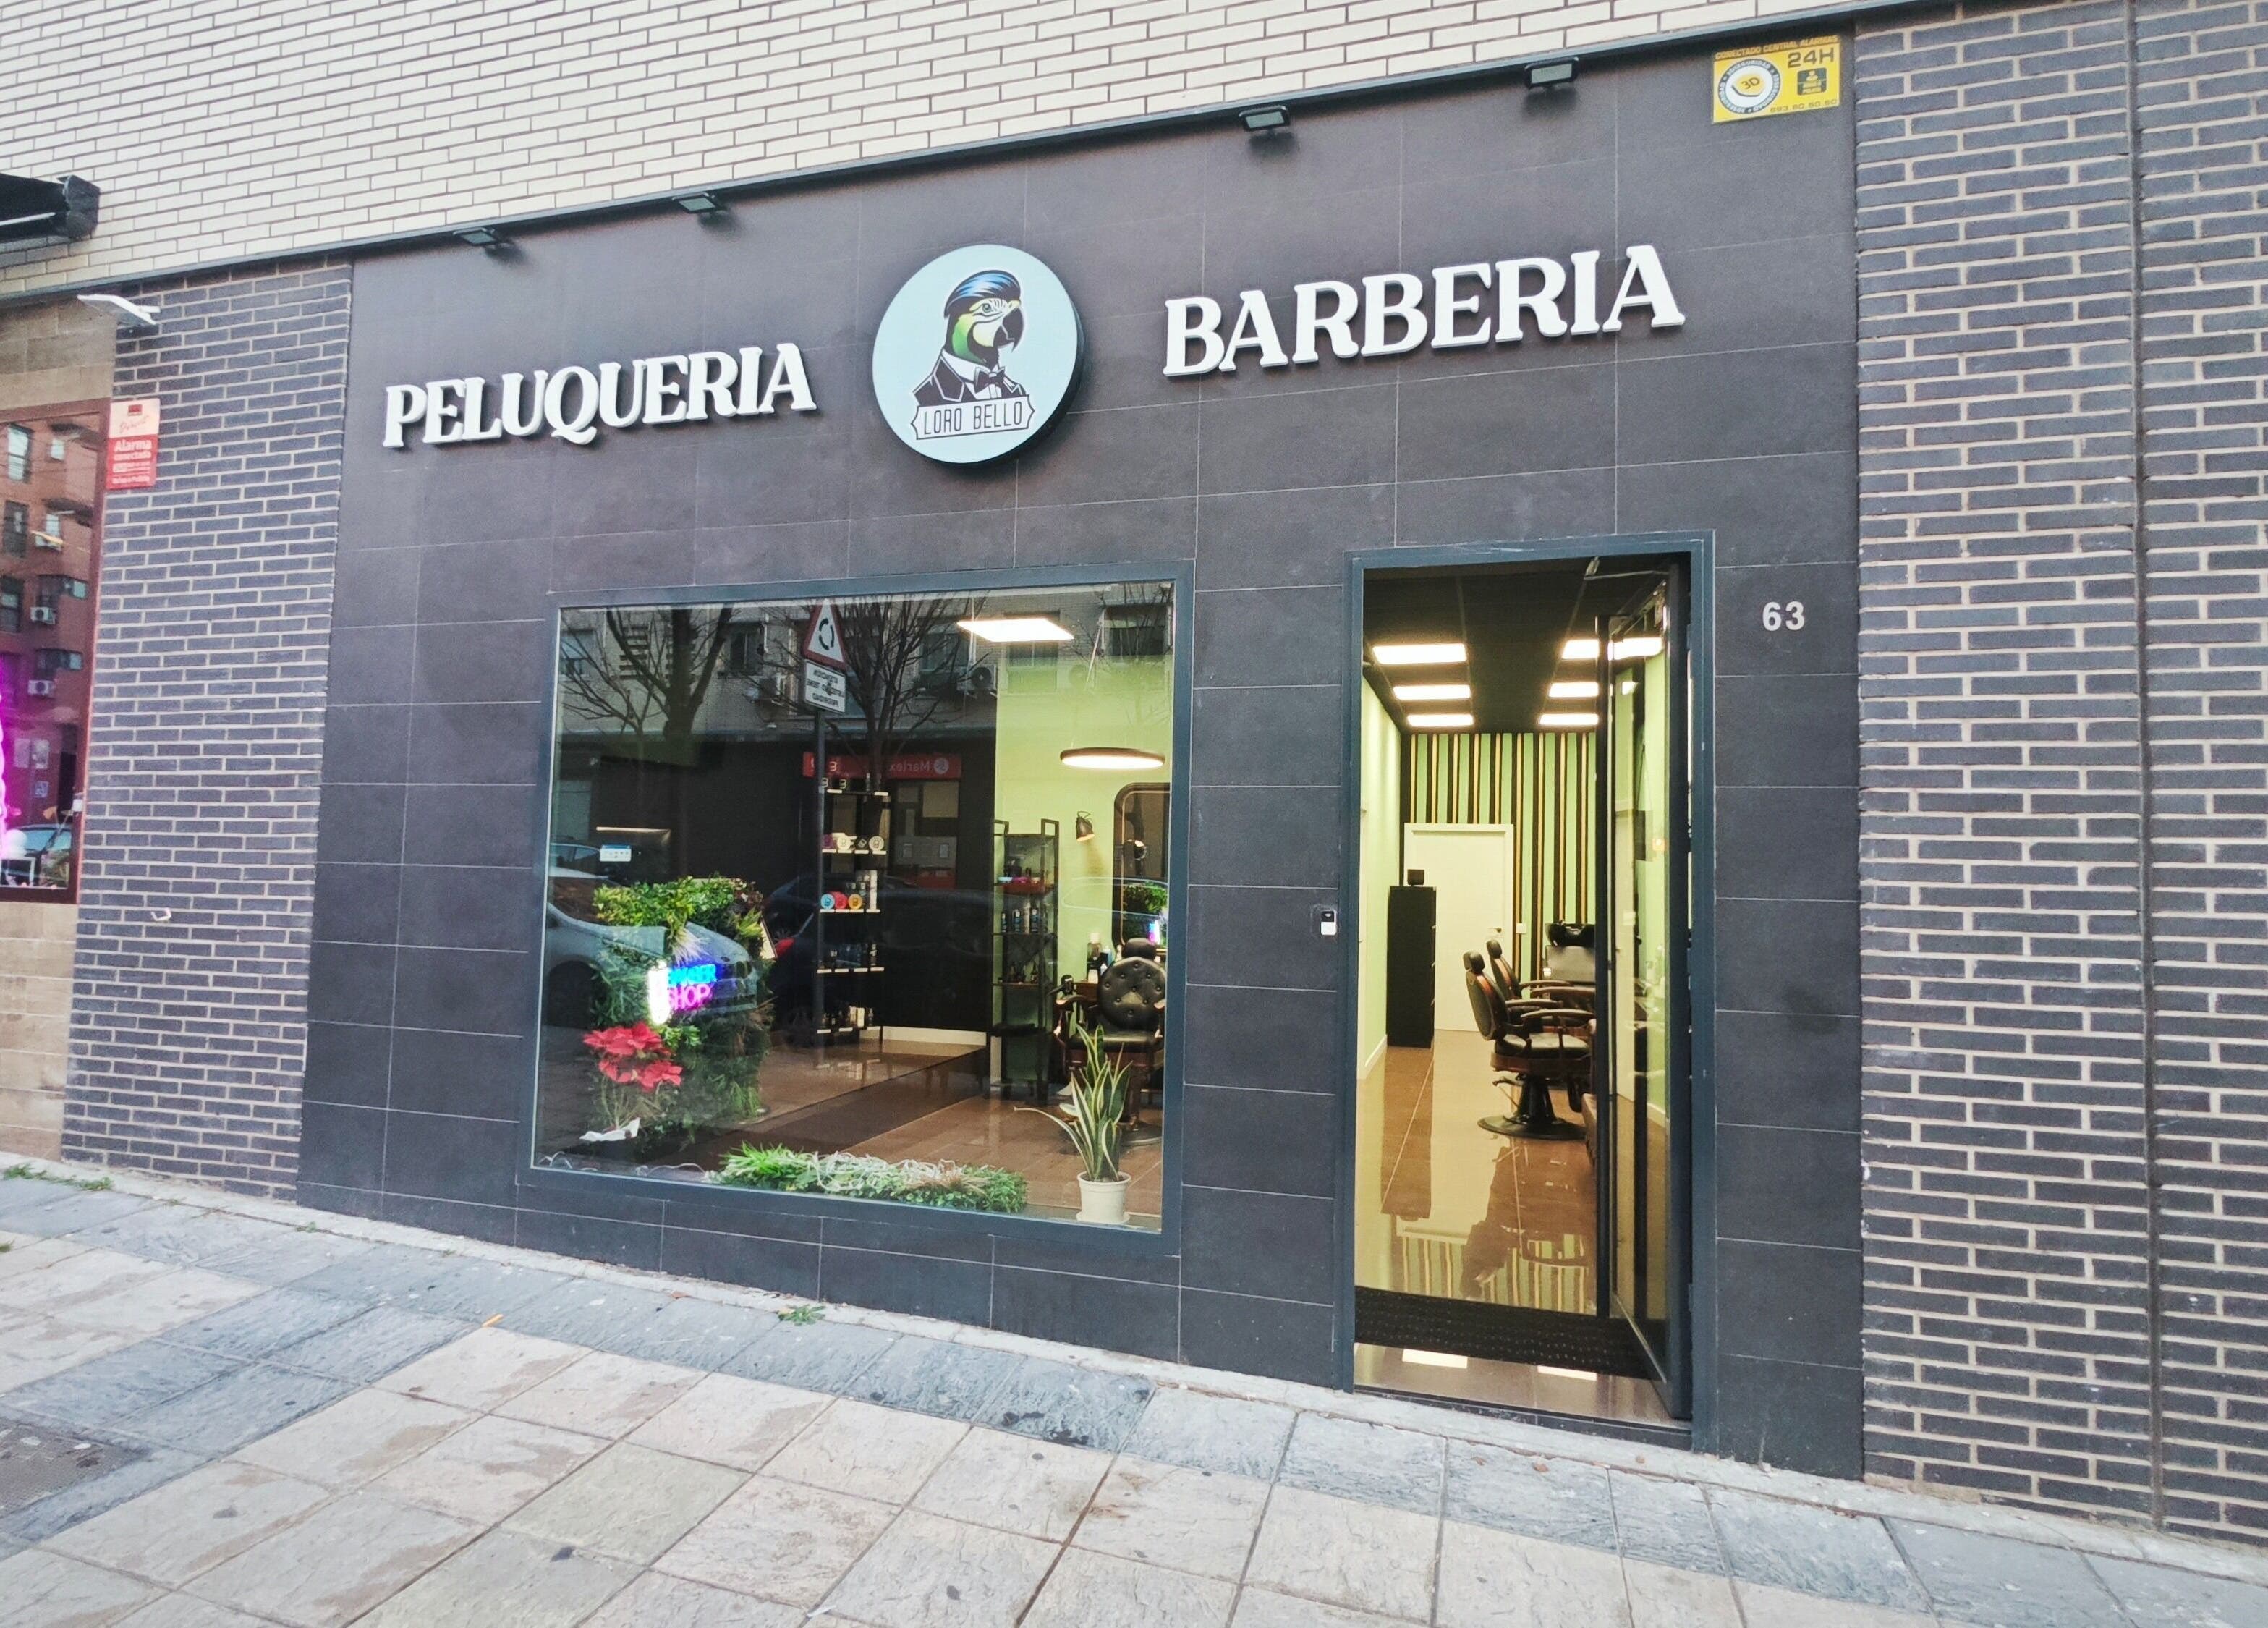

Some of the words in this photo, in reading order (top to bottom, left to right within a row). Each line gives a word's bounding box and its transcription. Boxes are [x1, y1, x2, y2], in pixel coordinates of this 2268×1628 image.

[1763, 41, 1798, 53] CENTRAL
[1788, 47, 1835, 69] 24H
[1741, 77, 1761, 90] 3D
[1163, 244, 1686, 376] BARBERIA
[381, 342, 817, 447] PELUQUERIA
[923, 408, 962, 435] LORO
[973, 401, 1022, 430] BELLO
[114, 438, 153, 452] Alarma
[1762, 601, 1805, 632] 63
[667, 983, 711, 1010] SHOP
